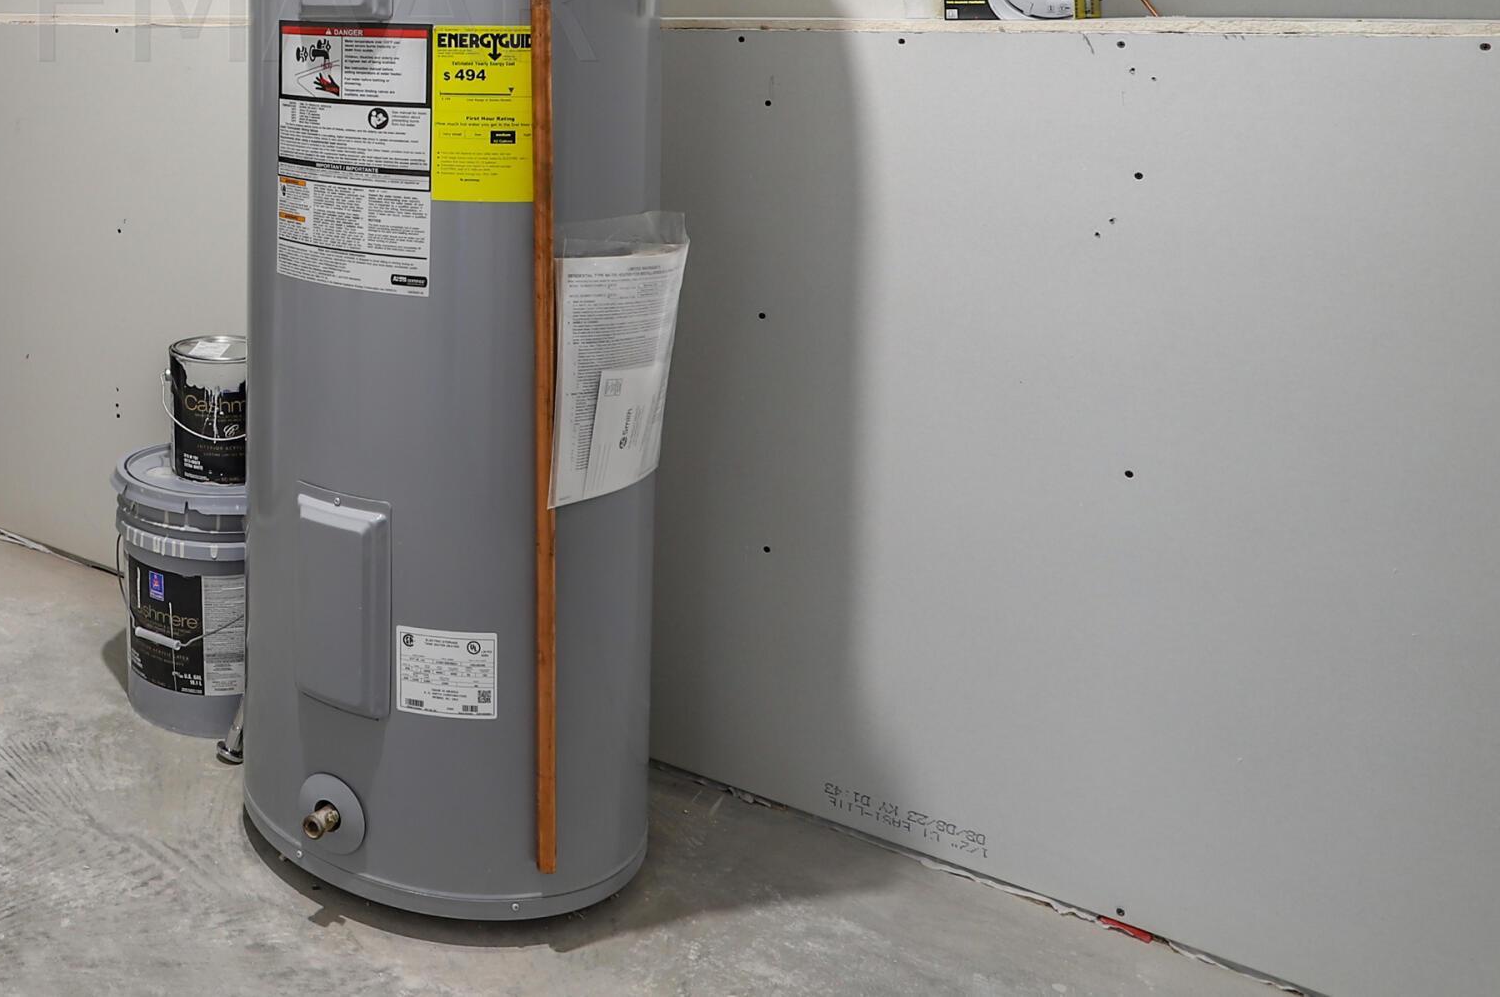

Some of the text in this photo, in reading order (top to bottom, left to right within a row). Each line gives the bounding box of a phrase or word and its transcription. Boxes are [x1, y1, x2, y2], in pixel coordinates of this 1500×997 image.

[444, 69, 486, 81] $ 494
[316, 163, 343, 171] IMPORTANT
